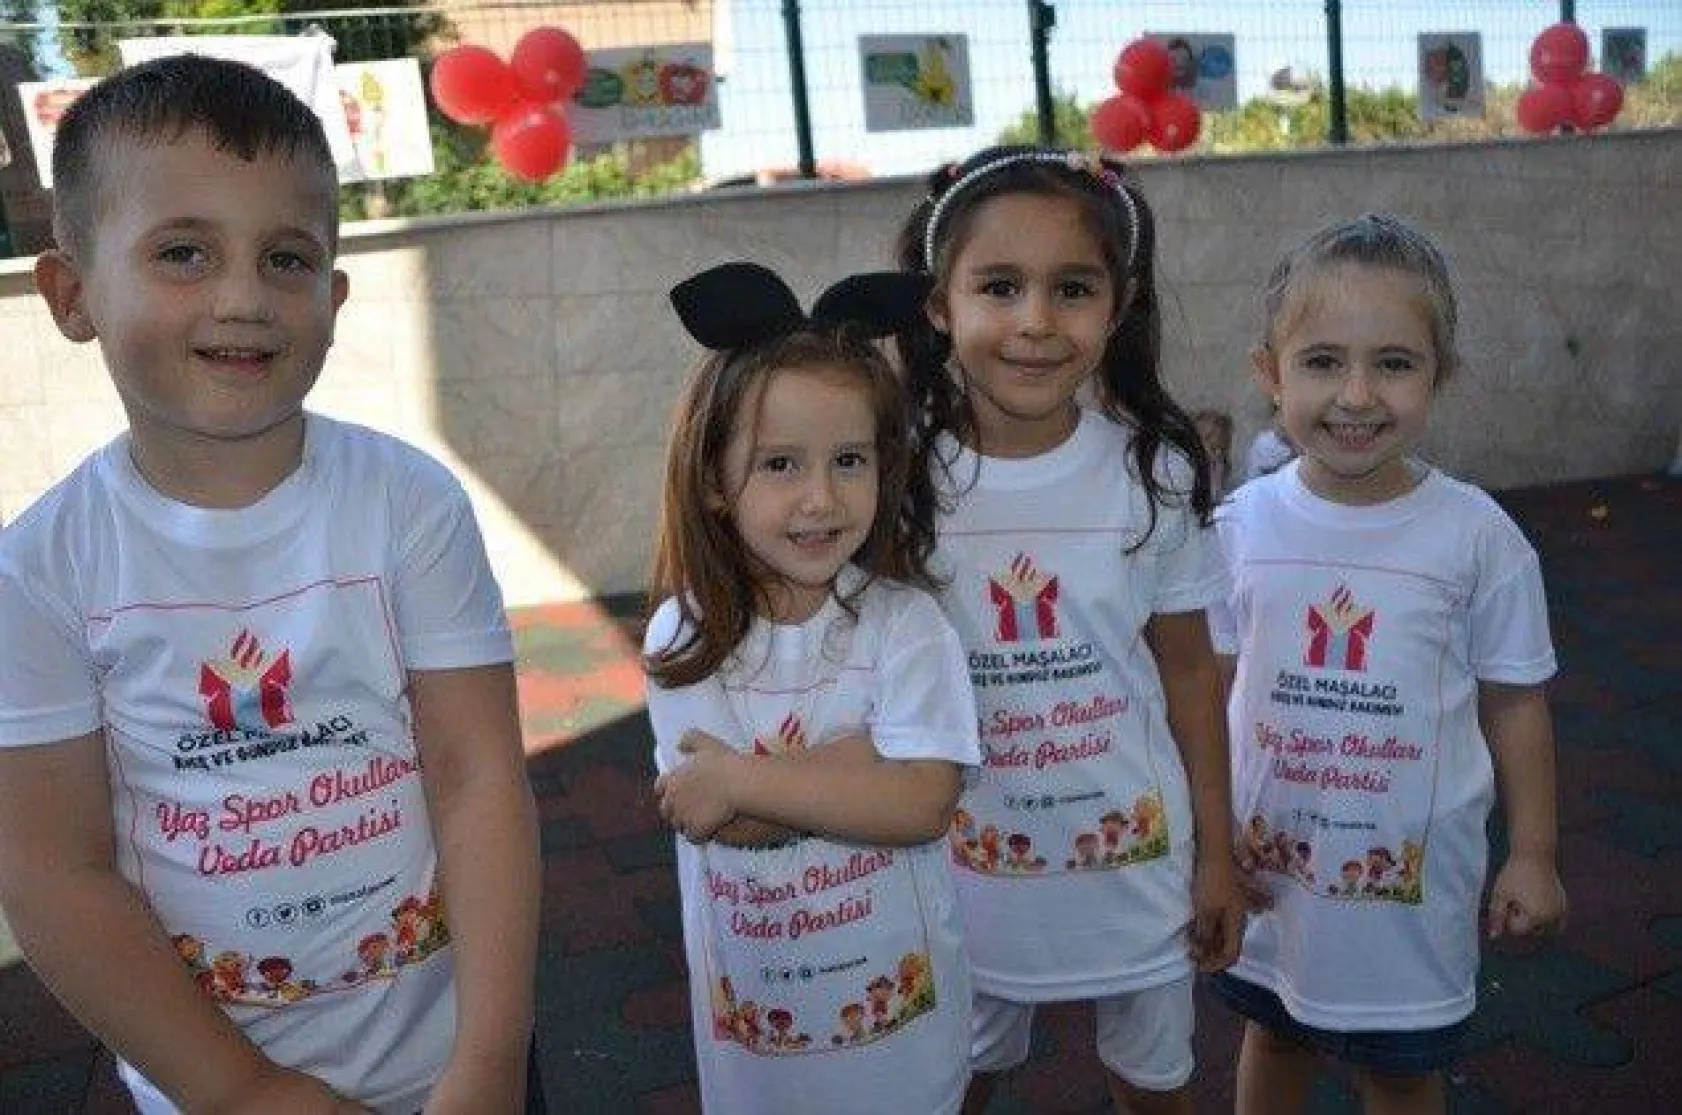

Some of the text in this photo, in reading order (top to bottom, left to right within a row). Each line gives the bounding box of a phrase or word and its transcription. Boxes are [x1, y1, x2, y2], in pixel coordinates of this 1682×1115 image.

[968, 648, 1009, 670] ÖZEL
[1276, 669, 1310, 691] ÖZEL
[990, 709, 1044, 737] Spor
[177, 727, 239, 752] ÖZEL
[1035, 731, 1111, 769] Partisi
[1286, 729, 1333, 757] Spor
[1320, 766, 1391, 792] Partisi
[156, 802, 210, 841] Yaz
[219, 795, 301, 833] Spor
[199, 799, 402, 875] Veda Partisi
[744, 877, 797, 905] Spor
[730, 889, 873, 940] Veda Partisi
